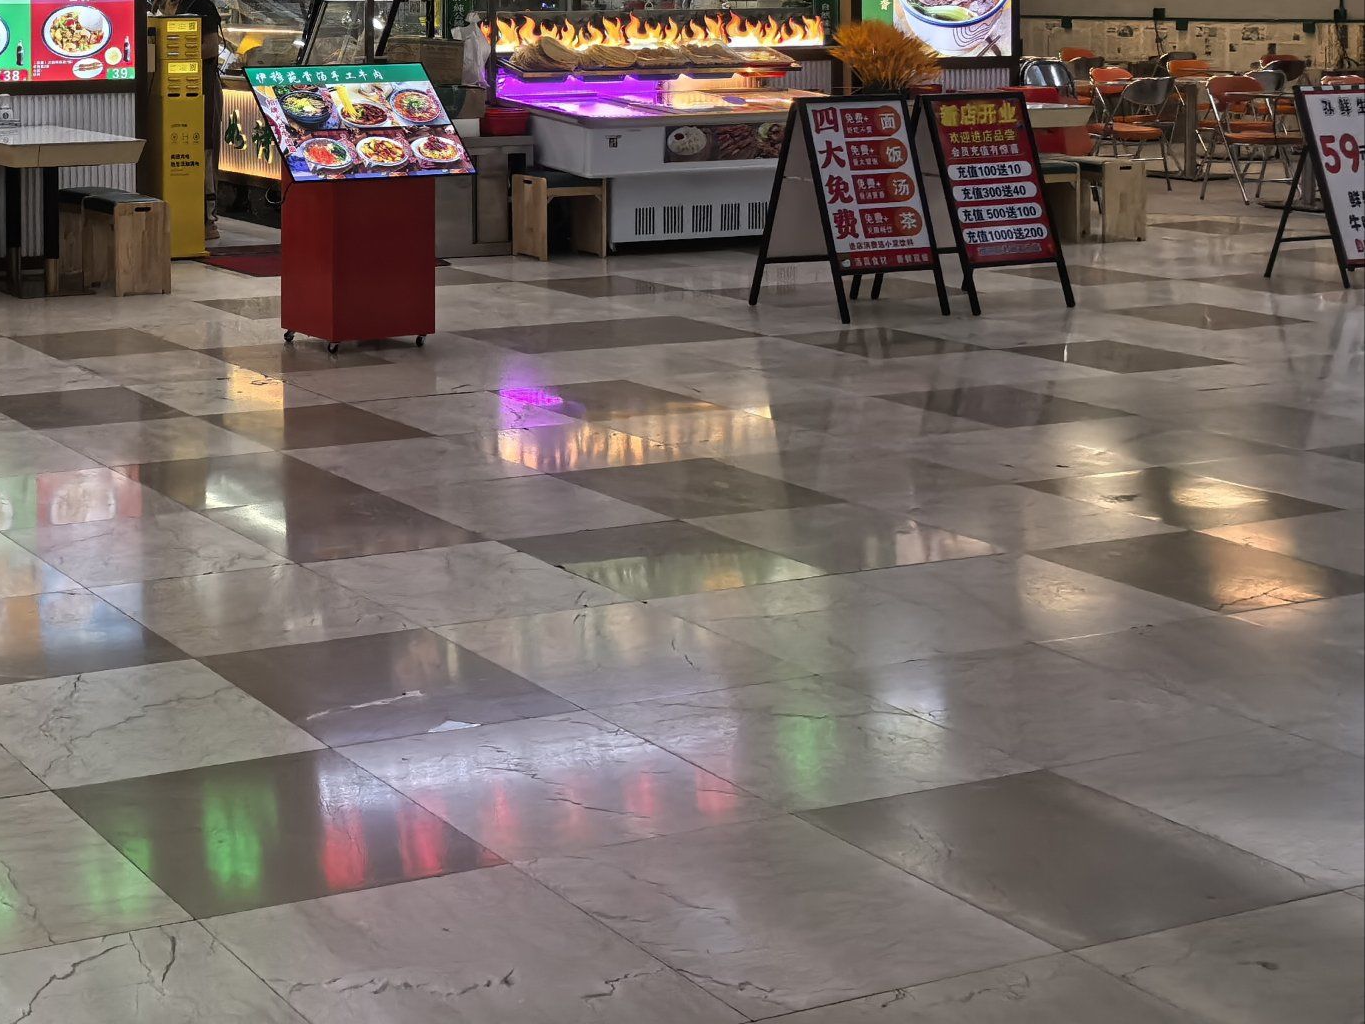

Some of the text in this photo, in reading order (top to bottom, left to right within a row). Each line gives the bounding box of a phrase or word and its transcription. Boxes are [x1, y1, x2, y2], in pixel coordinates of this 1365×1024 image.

[3, 70, 20, 82] 38
[112, 68, 128, 79] 39
[879, 113, 896, 130] 面
[939, 100, 1018, 127] 新店开业
[949, 129, 1018, 143] 欢迎进店品尝
[886, 145, 905, 163] 饭
[811, 106, 860, 240] 四大免费
[957, 163, 1022, 179] 充值100送10
[892, 179, 911, 196] 汤
[961, 184, 1027, 200] 充值300送40
[898, 211, 918, 230] 茶
[966, 226, 1045, 243] 充值1000送200
